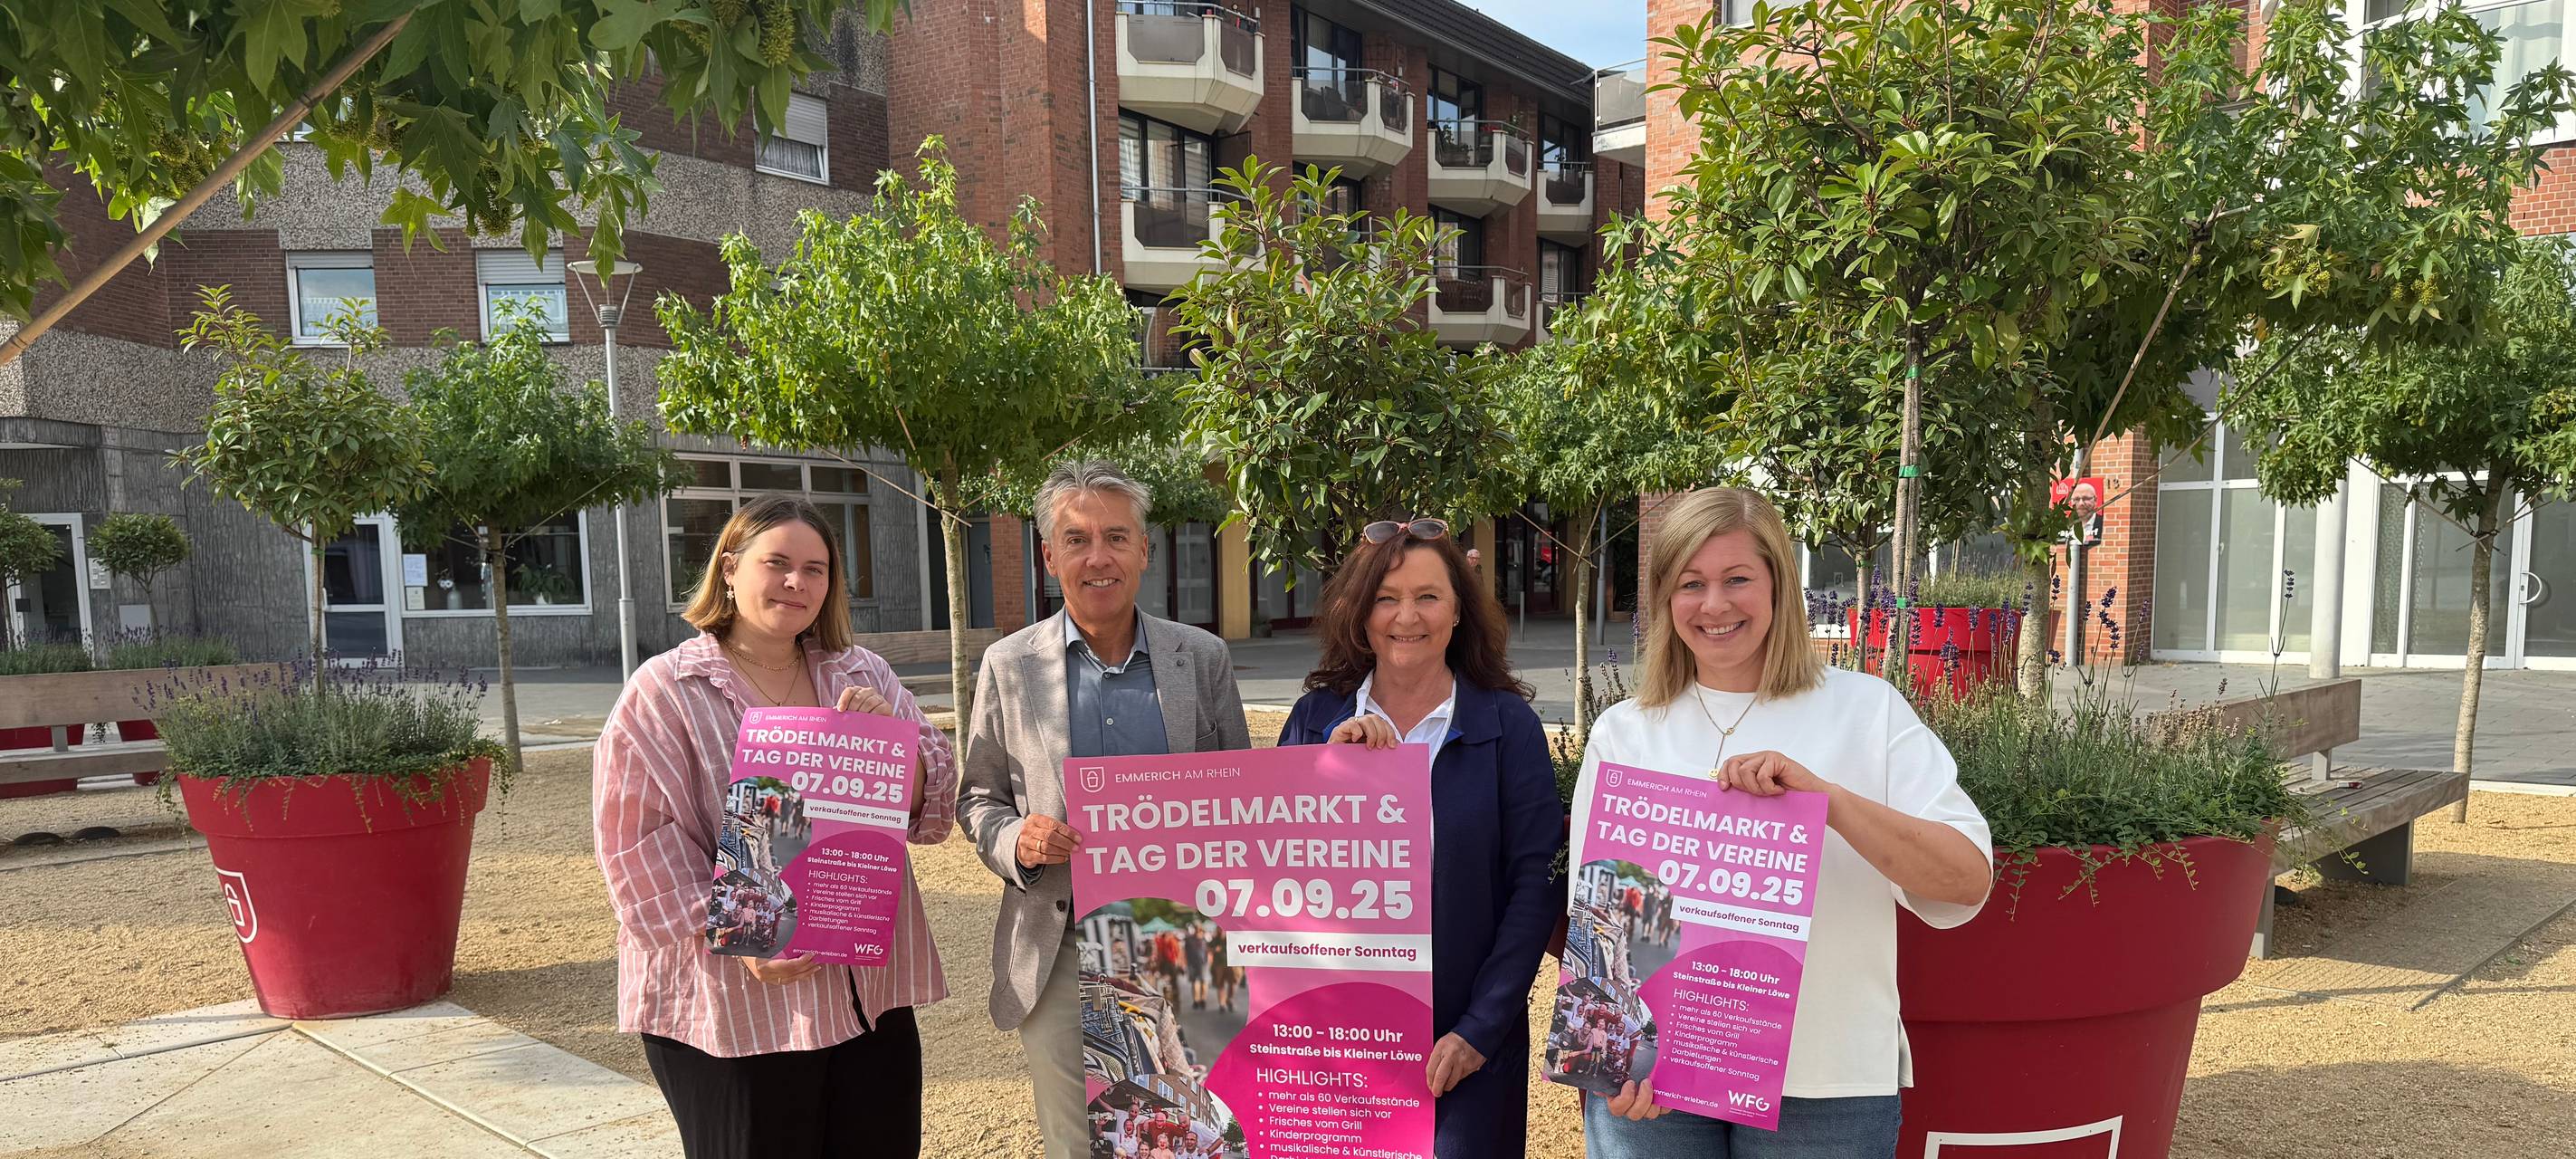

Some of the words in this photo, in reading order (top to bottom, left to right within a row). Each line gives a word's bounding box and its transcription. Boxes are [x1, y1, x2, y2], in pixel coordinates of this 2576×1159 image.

[746, 726, 888, 754] TRÖDELMARKT
[892, 742, 905, 758] &
[742, 749, 781, 763] TAG
[786, 752, 824, 768] DER
[828, 755, 905, 780] VEREINE
[1115, 771, 1180, 783] EMMERICH
[1185, 769, 1203, 780] AM
[1207, 767, 1240, 779] RHEIN
[791, 771, 903, 803] 07.09.25
[1627, 779, 1669, 792] EMMERICH
[1671, 786, 1684, 794] AM
[1685, 788, 1707, 798] RHEIN
[810, 806, 869, 818] verkaufsoffener
[871, 813, 902, 824] Sonntag
[1083, 794, 1367, 833] TRÖDELMARKT
[1377, 794, 1407, 823] &
[1602, 793, 1785, 841] TRÖDELMARKT
[1789, 824, 1808, 844] &
[821, 848, 843, 857] 13:00
[852, 851, 873, 860] 18:00
[874, 855, 889, 863] Uhr
[1598, 820, 1647, 847] TAG
[1652, 831, 1700, 857] DER
[1707, 840, 1808, 874] VEREINE
[807, 857, 845, 867] Steinstraße
[1086, 844, 1167, 875] TAG
[1177, 840, 1248, 870] DER
[1257, 839, 1410, 868] VEREINE
[808, 870, 868, 884] HIGHLIGHTS:
[1658, 859, 1804, 905] 07.09.25
[811, 903, 860, 912] Kinderprogramm
[1195, 878, 1413, 920] 07.09.25
[809, 915, 848, 924] Darbietungen
[1679, 905, 1756, 924] verkaufsoffener
[1758, 917, 1799, 934] Sonntag
[854, 926, 876, 934] Sonntag
[854, 943, 883, 955] WFG
[1237, 942, 1352, 957] verkaufsoffener
[1354, 944, 1417, 961] Sonntag
[1692, 961, 1719, 973] 13:00
[1730, 968, 1757, 981] 18:00
[1760, 973, 1780, 984] Uhr
[1673, 972, 1722, 986] Steinstraße
[1723, 981, 1735, 990] bis
[1737, 983, 1767, 995] Kleiner
[1768, 989, 1790, 999] Löwe
[1674, 988, 1750, 1011] HIGHLIGHTS:
[1679, 1005, 1699, 1013] mehr
[1701, 1008, 1711, 1016] als
[1676, 1021, 1705, 1032] Frisches
[1707, 1029, 1723, 1037] vom
[1678, 1012, 1705, 1023] Vereine
[1732, 1023, 1748, 1032] sich
[1273, 1024, 1312, 1039] 13:00
[1329, 1027, 1369, 1041] 18:00
[1374, 1029, 1403, 1043] Uhr
[1674, 1030, 1738, 1049] Kinderprogramm
[1250, 1044, 1321, 1057] Steinstraße
[1323, 1046, 1341, 1058] bis
[1344, 1048, 1388, 1060] Kleiner
[1390, 1050, 1422, 1062] Löwe
[1672, 1047, 1722, 1063] Darbietungen
[1674, 1039, 1721, 1054] musikalische
[1256, 1068, 1369, 1087] HIGHLIGHTS:
[1728, 1068, 1760, 1081] Sonntag
[1269, 1091, 1296, 1100] mehr
[1300, 1092, 1314, 1101] als
[1318, 1093, 1331, 1102] 60
[1334, 1094, 1419, 1107] Verkaufsstände
[1654, 1088, 1719, 1108] mmerich-erleben.de
[1728, 1089, 1770, 1112] WFG
[1269, 1104, 1309, 1114] Vereine
[1312, 1106, 1347, 1116] stellen
[1350, 1108, 1371, 1118] sich
[1375, 1110, 1392, 1119] vor
[1269, 1116, 1312, 1126] Frisches
[1315, 1120, 1339, 1128] vom
[1341, 1121, 1362, 1130] Grill
[1270, 1129, 1362, 1144] Kinderprogramm
[1271, 1144, 1340, 1154] musikalische
[1342, 1146, 1350, 1155] &
[1353, 1147, 1423, 1159] künstlerische
